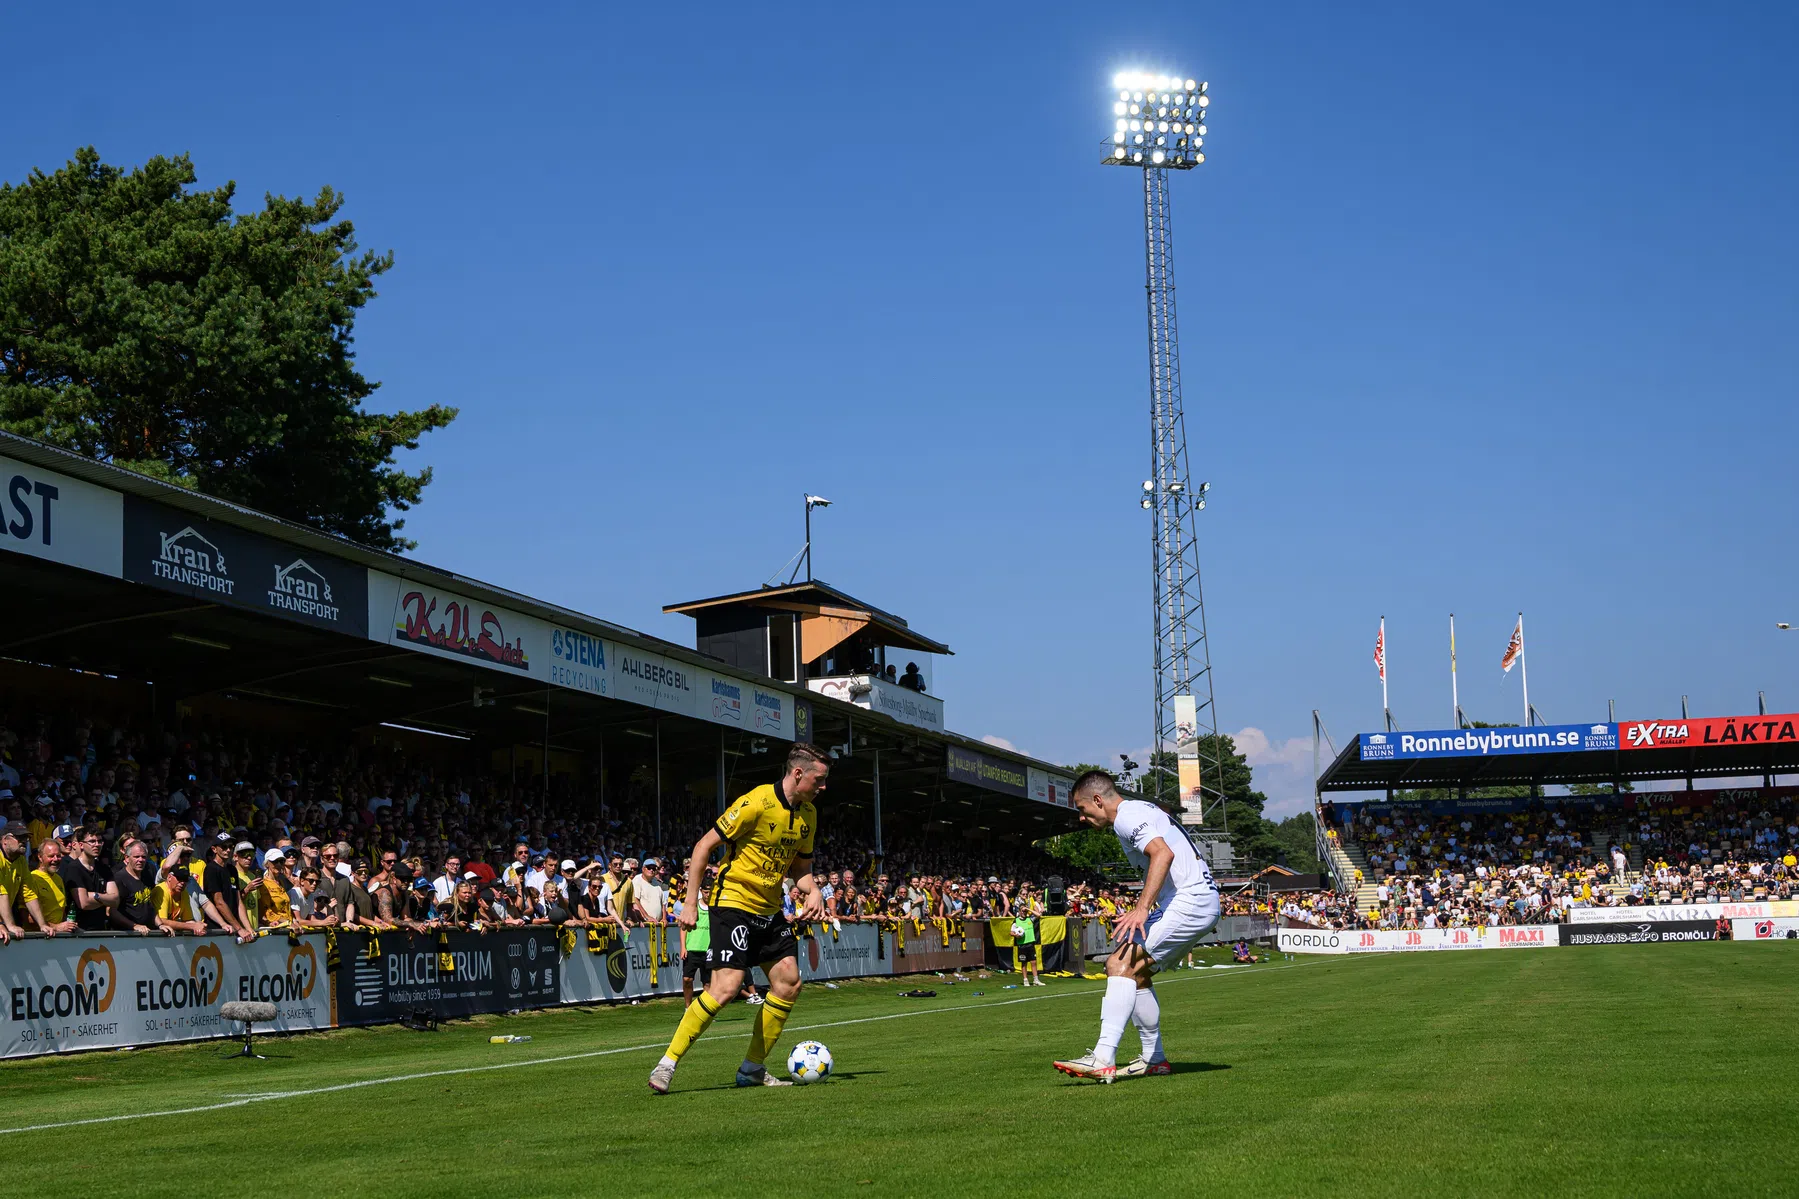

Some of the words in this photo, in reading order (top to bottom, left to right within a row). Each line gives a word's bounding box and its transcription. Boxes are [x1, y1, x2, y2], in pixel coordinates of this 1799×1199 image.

[0, 475, 58, 546] ST
[160, 531, 210, 572] Kran
[152, 560, 234, 595] TRANSPORT
[274, 564, 318, 600] Kran
[268, 591, 339, 621] TRANSPORT
[565, 630, 606, 671] STENA
[552, 665, 607, 694] RECYCLING
[1703, 719, 1796, 743] LÄKTA
[1401, 731, 1579, 754] Ronnebybrunn.se
[1585, 740, 1616, 748] BRUNN
[1364, 749, 1394, 757] BRUNN
[1646, 906, 1712, 920] SÄKRA
[1722, 905, 1762, 917] MAXI
[1360, 932, 1375, 946] JB
[1406, 931, 1422, 945] JB
[1453, 930, 1468, 944] JB
[1499, 928, 1544, 942] MAXI
[1570, 932, 1659, 944] HUSVAGNS-EXPO
[720, 949, 733, 962] 17
[137, 977, 207, 1011] ELCOM
[239, 973, 302, 1003] ELCOM
[388, 990, 412, 1004] Mobility
[412, 989, 427, 1001] since
[428, 988, 441, 1000] 1959
[12, 984, 98, 1021] ELCOM
[145, 1019, 158, 1031] SOL
[164, 1018, 172, 1029] EL
[178, 1017, 184, 1028] IT
[190, 1014, 221, 1027] SÄKERHET
[287, 1008, 316, 1019] SÄKERHET
[21, 1029, 37, 1042] SOL
[45, 1028, 54, 1040] EL
[62, 1026, 70, 1038] IT
[78, 1022, 118, 1037] SÄKERHET
